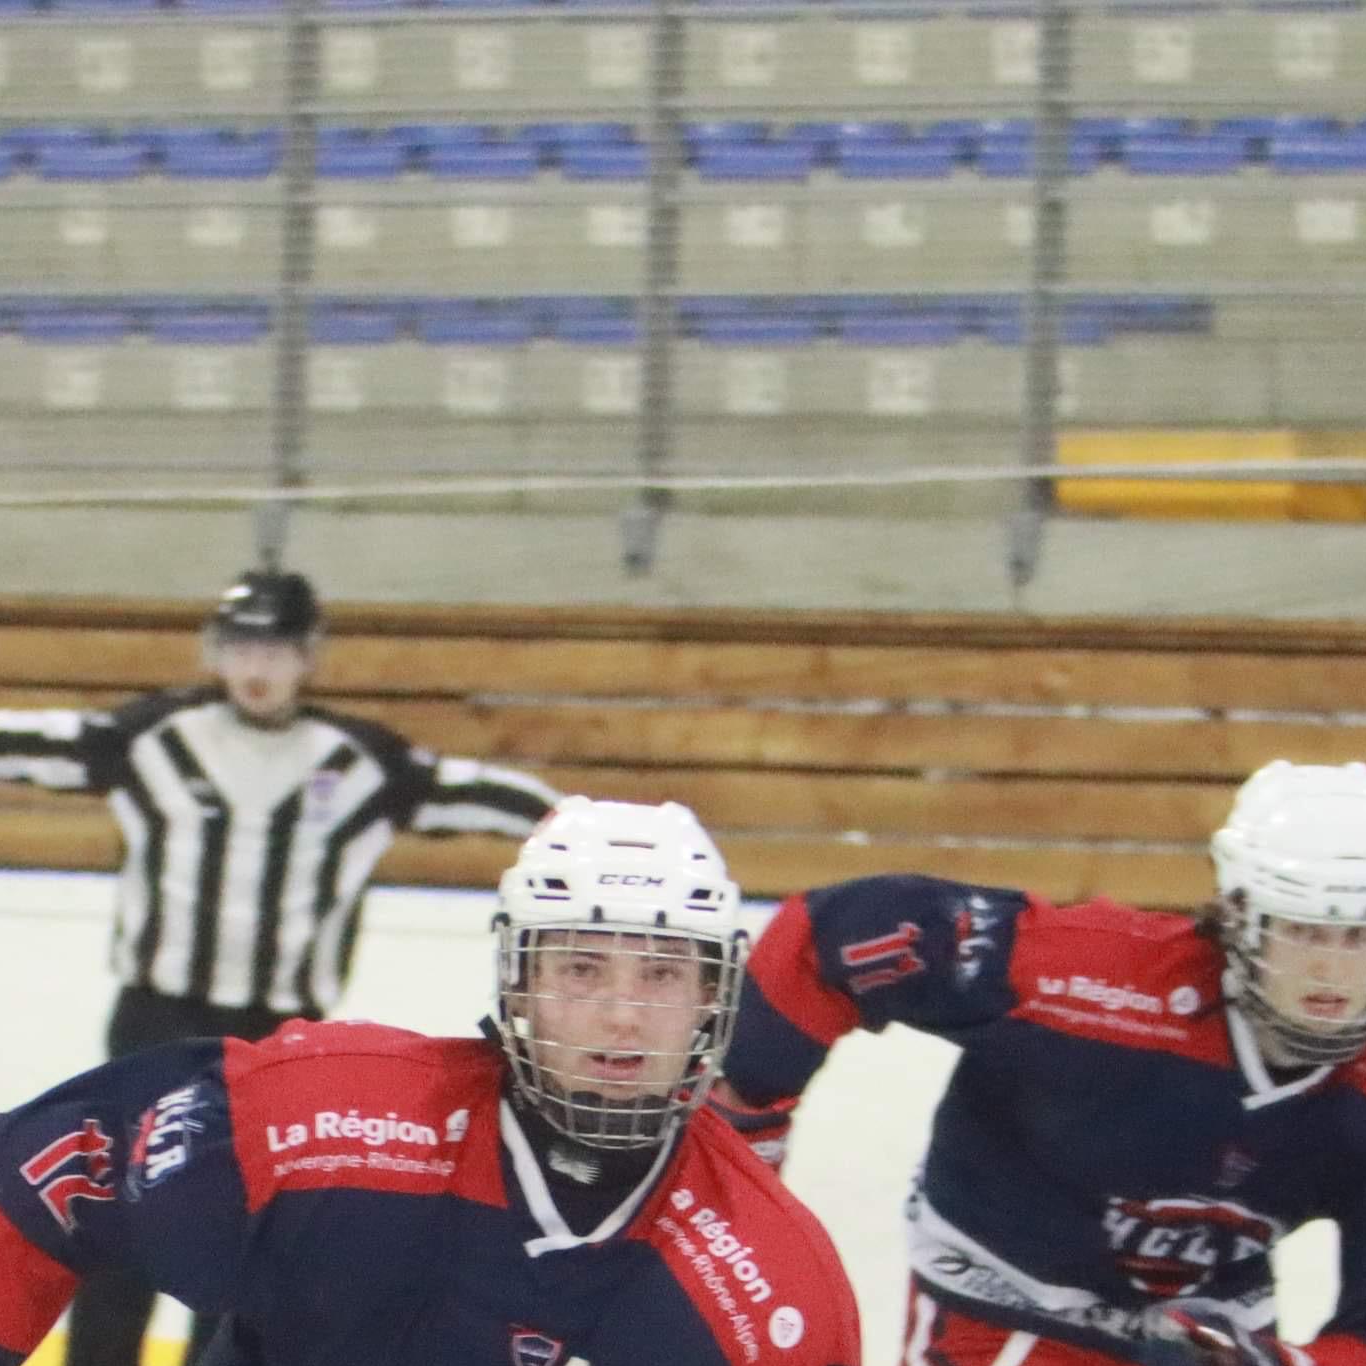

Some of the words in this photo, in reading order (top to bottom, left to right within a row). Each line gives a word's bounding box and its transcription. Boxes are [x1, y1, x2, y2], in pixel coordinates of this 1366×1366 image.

[597, 873, 666, 888] CCM
[1068, 975, 1163, 1015] Région
[266, 1123, 309, 1153] La
[314, 1109, 439, 1146] Région
[669, 1188, 696, 1212] a
[688, 1206, 773, 1304] Région
